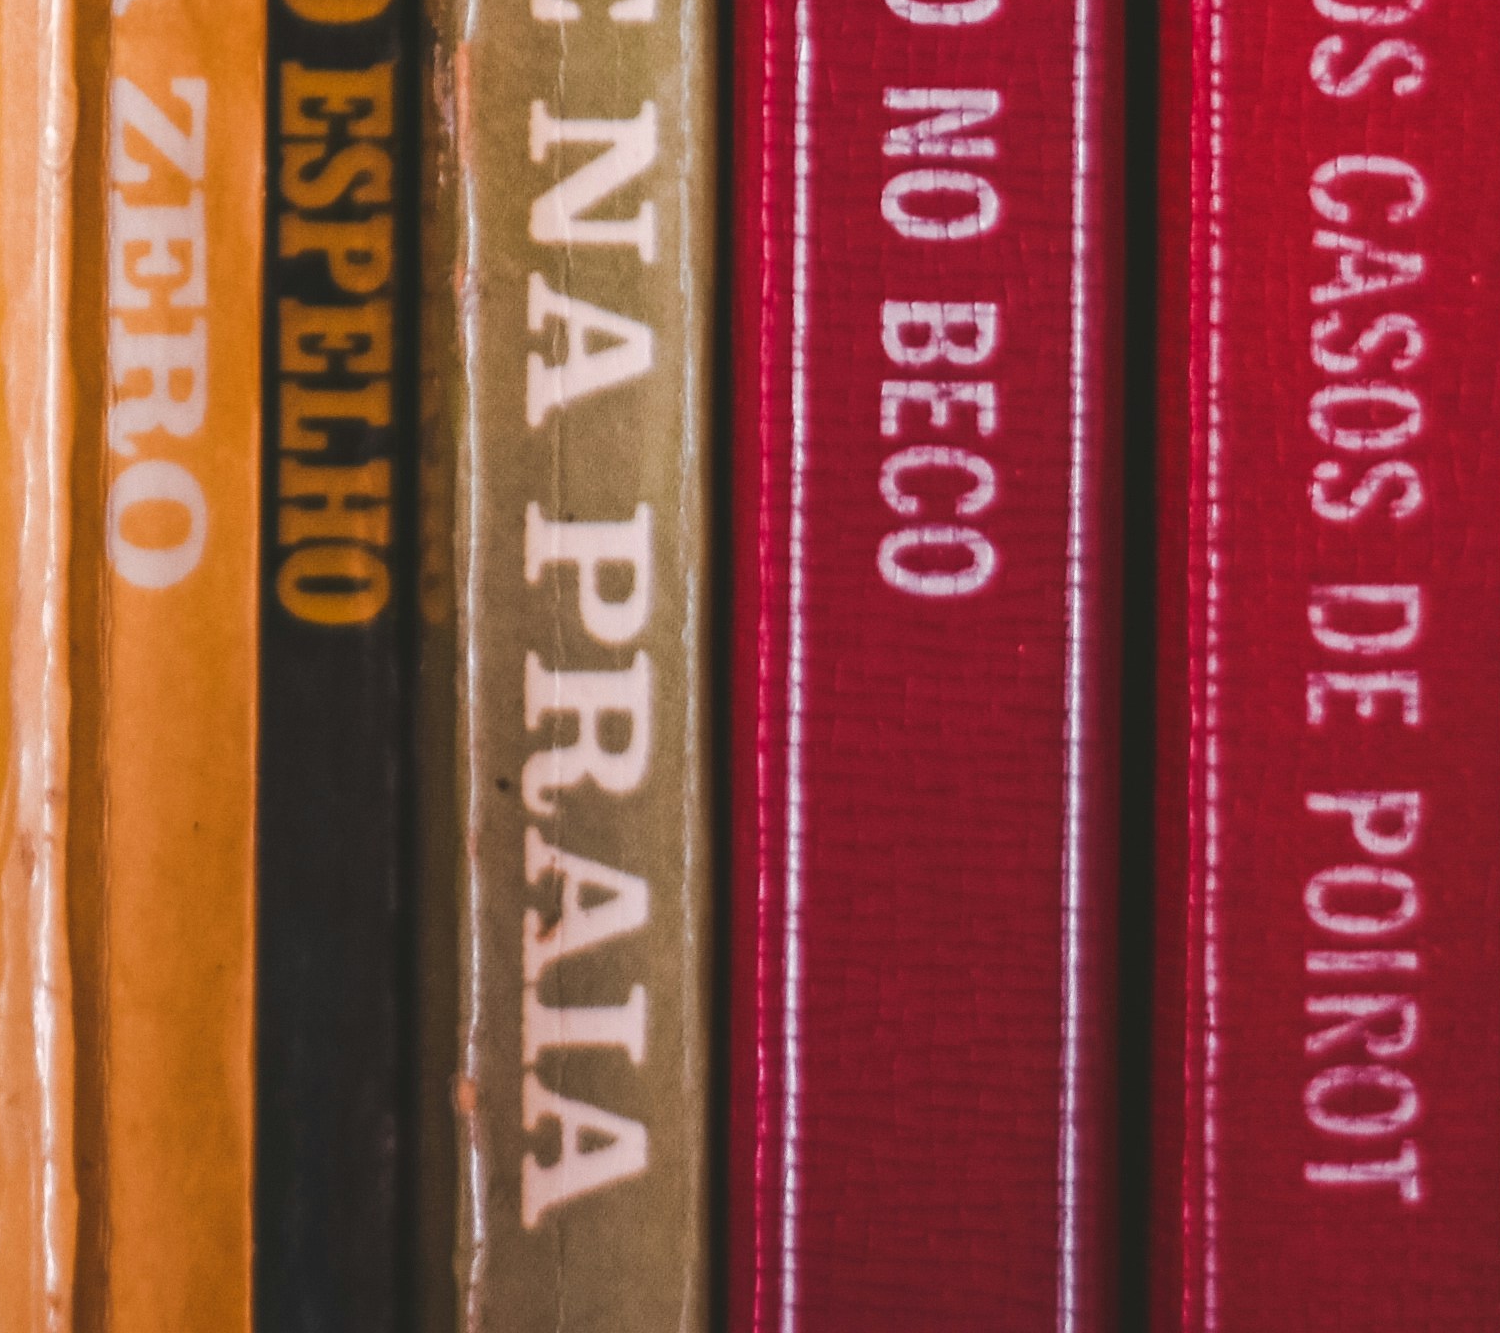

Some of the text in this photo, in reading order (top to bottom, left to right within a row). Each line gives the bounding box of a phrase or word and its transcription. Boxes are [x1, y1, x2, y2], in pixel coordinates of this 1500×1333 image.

[105, 76, 207, 590] ZERO
[275, 60, 393, 625] ESPELHO
[525, 99, 657, 429] NA
[880, 85, 1000, 242] NO
[1308, 152, 1425, 524] CASOS
[876, 302, 998, 598] BECO
[1305, 583, 1422, 727] DE
[520, 500, 652, 1231] PRAIA
[1303, 790, 1421, 1202] POIROT
